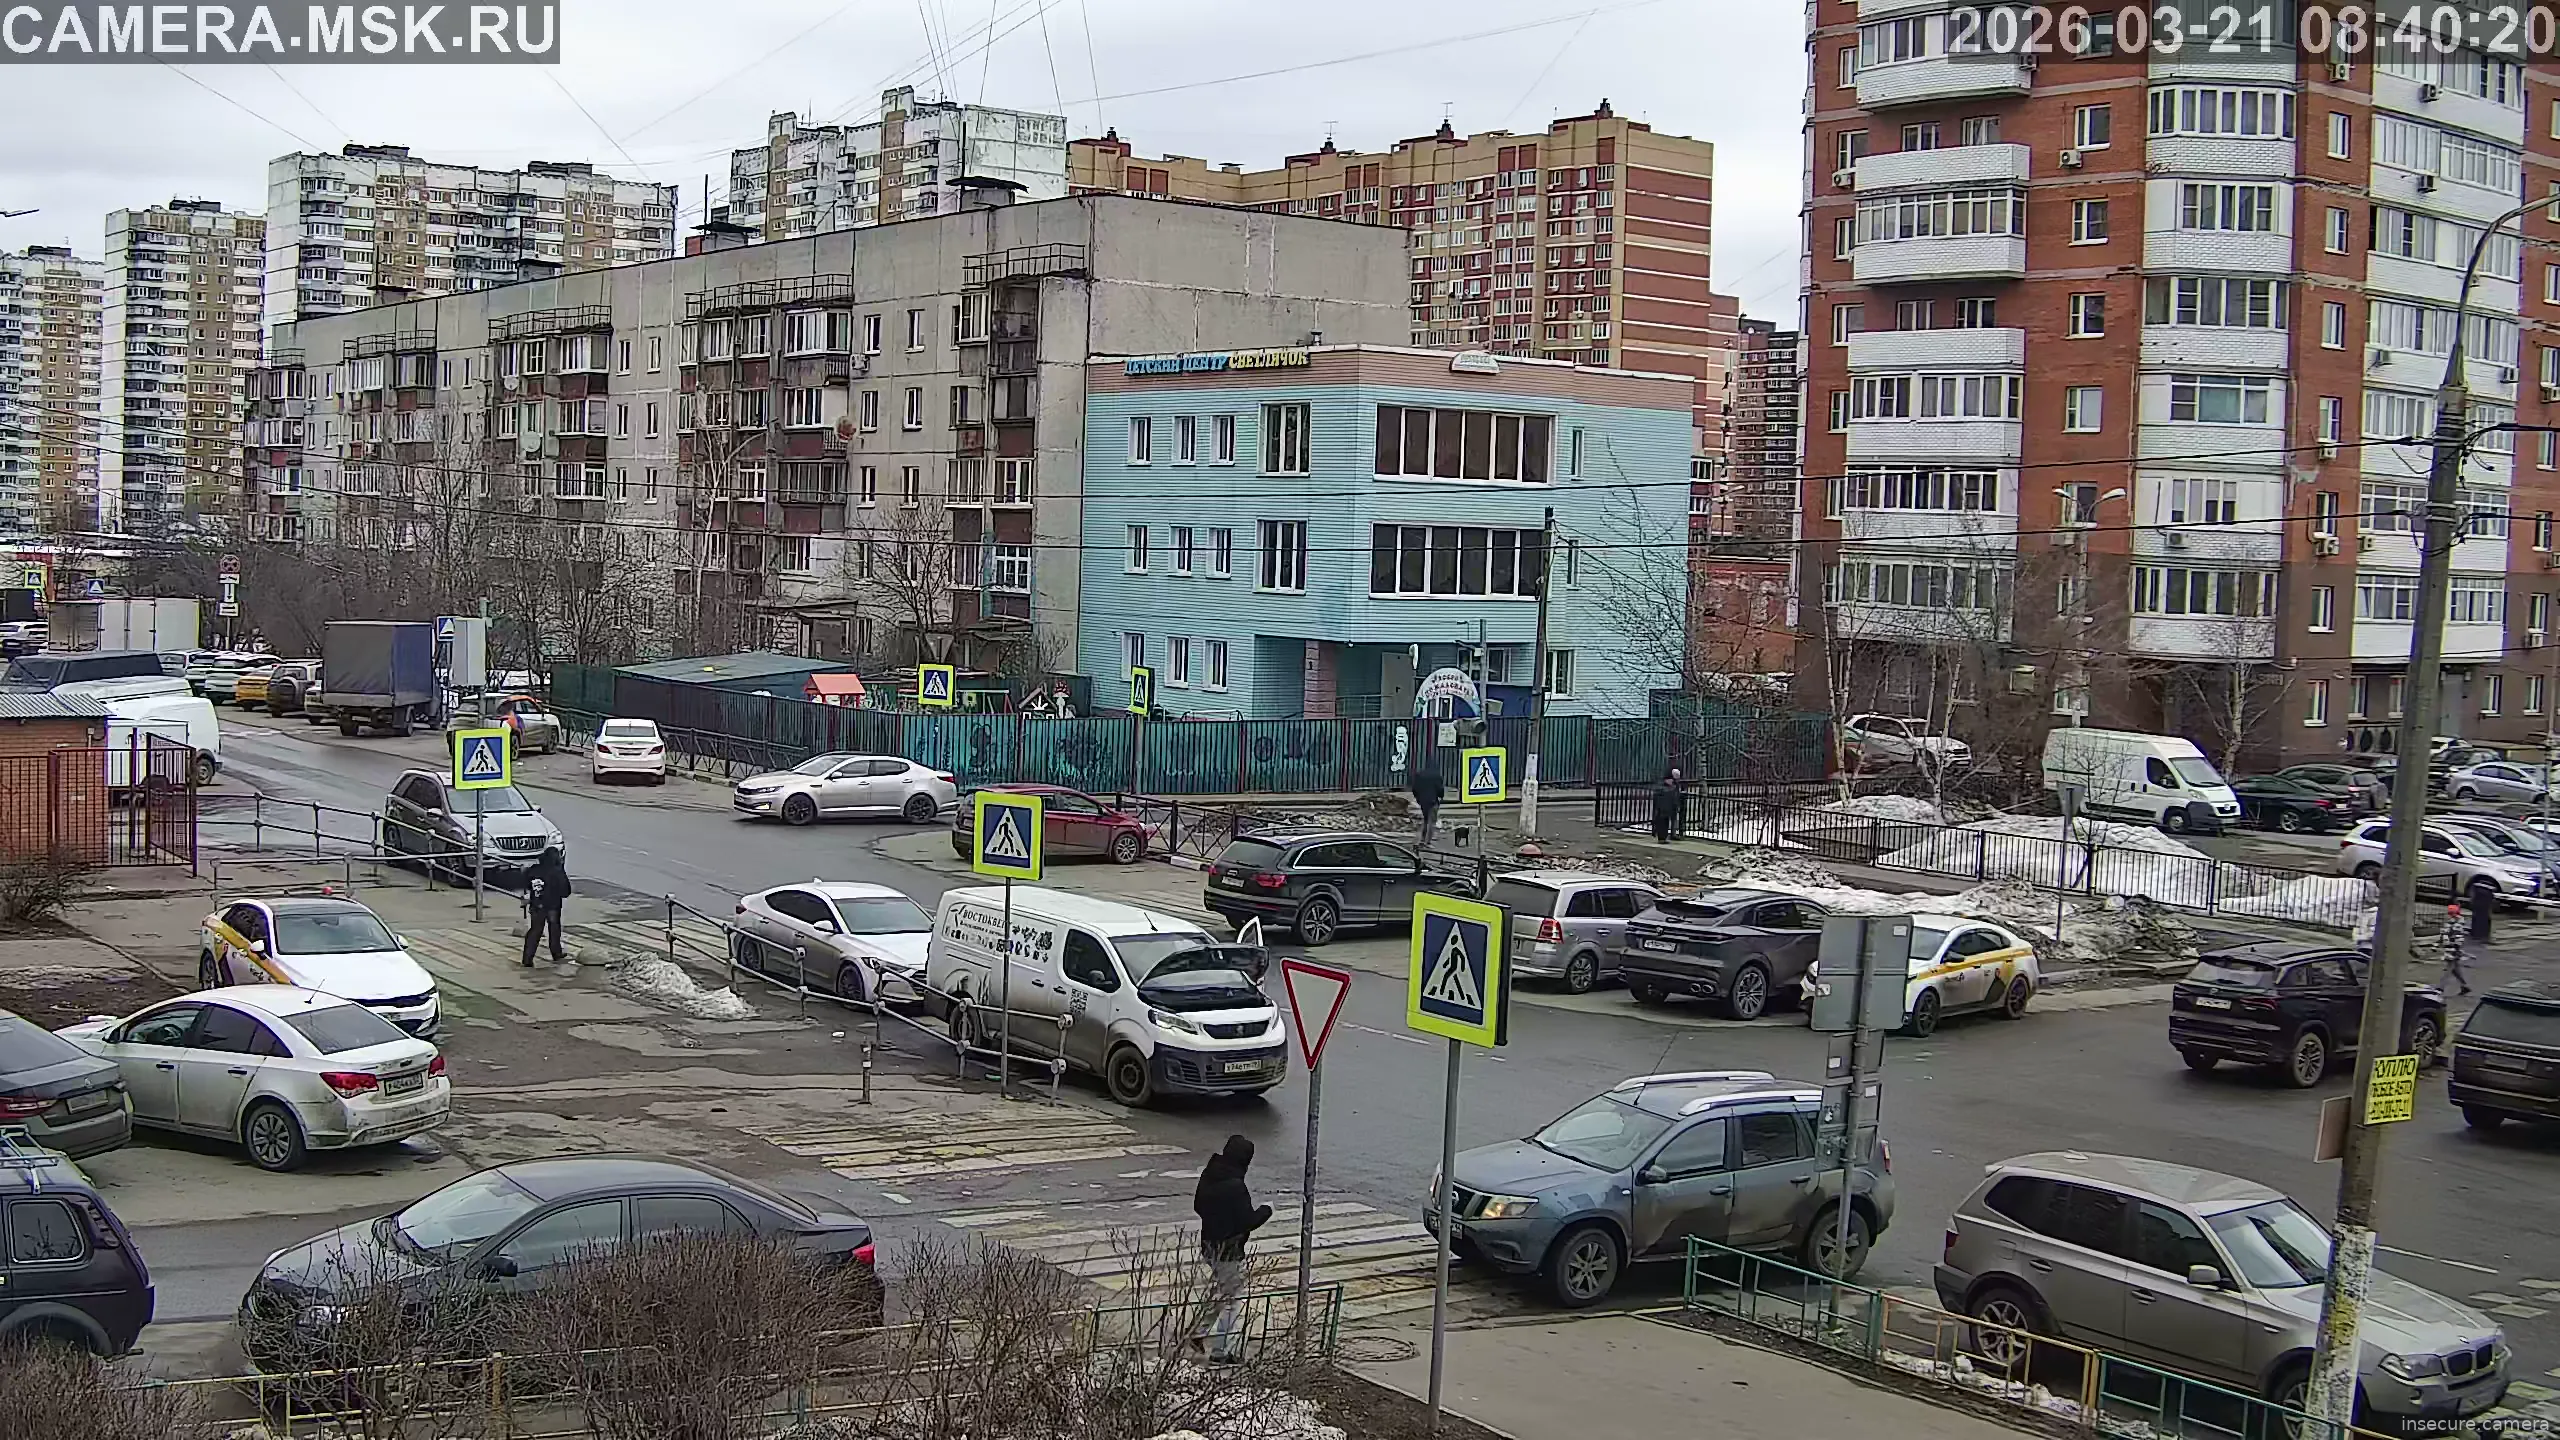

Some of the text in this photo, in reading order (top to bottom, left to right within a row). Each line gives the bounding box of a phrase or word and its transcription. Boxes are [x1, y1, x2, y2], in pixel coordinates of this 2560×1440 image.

[1183, 355, 1227, 371] ЦЕНТР
[1229, 350, 1309, 369] СВЕТЛЯЧОК
[2375, 1058, 2416, 1078] КУПЛЮ
